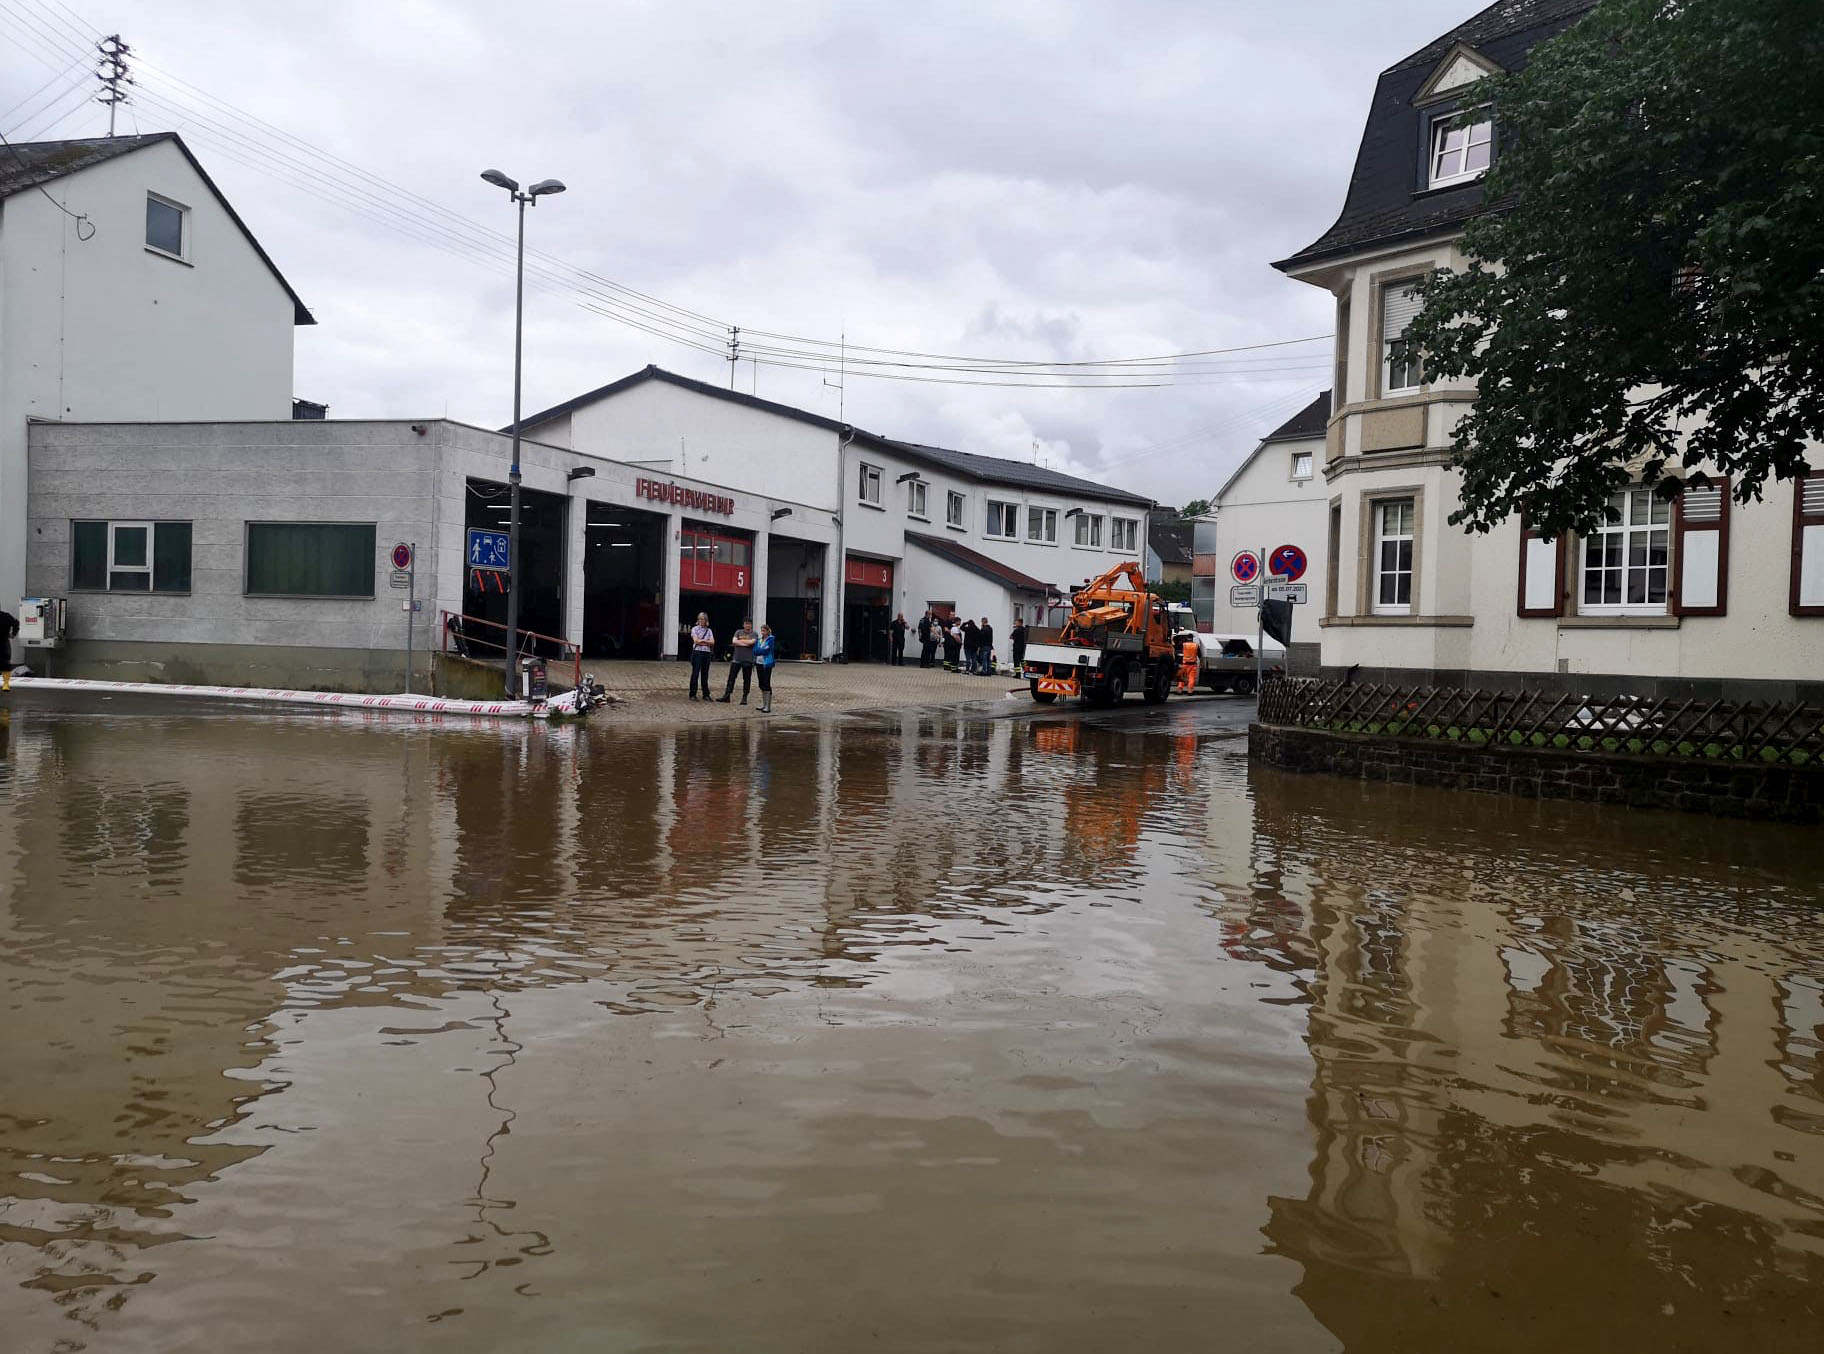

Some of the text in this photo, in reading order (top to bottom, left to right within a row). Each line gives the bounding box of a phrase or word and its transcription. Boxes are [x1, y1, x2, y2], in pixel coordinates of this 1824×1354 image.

[636, 478, 735, 515] FEUERWEHR
[737, 571, 744, 587] 5
[882, 569, 888, 583] 3
